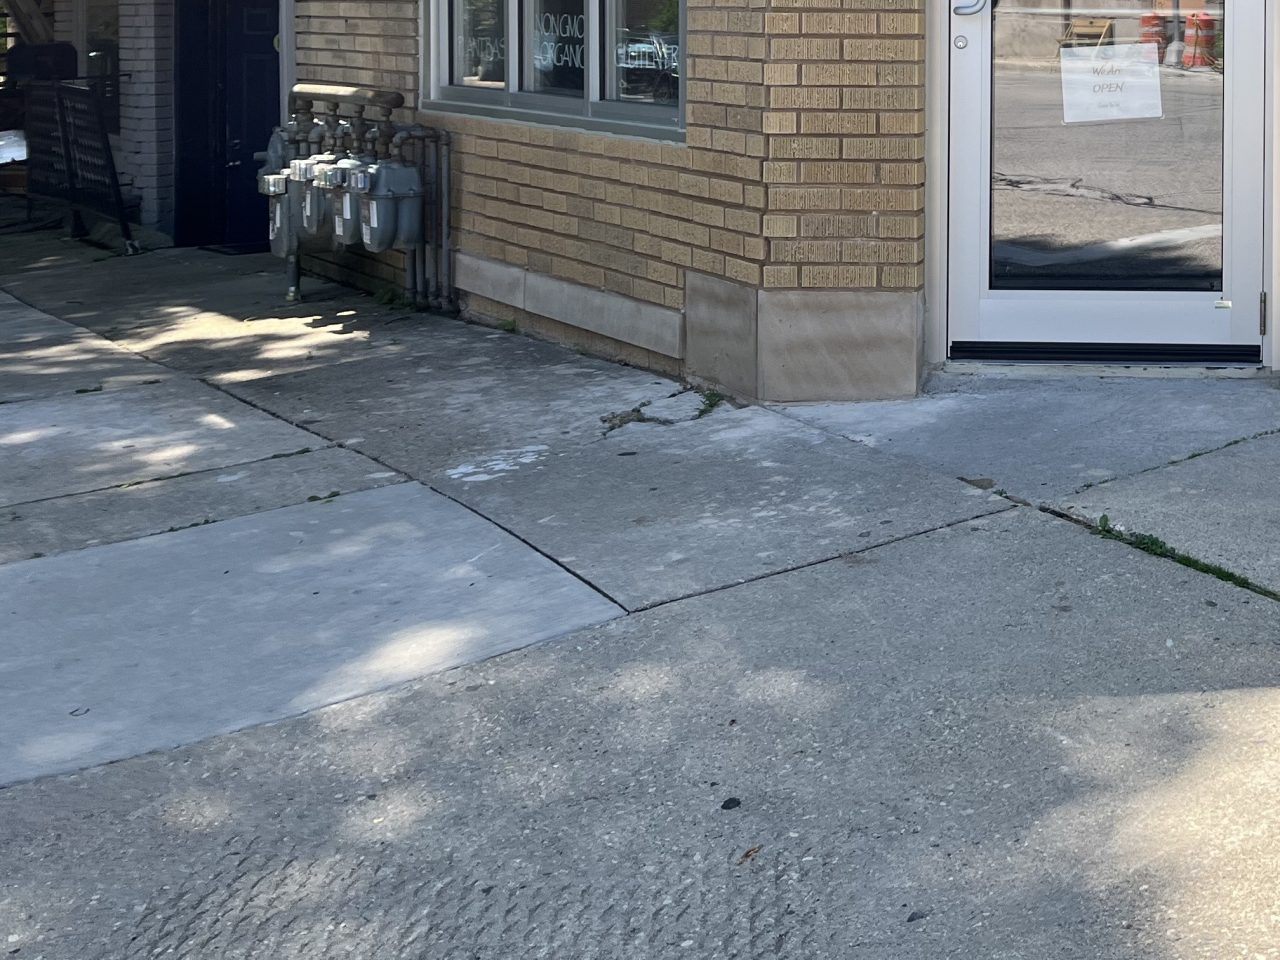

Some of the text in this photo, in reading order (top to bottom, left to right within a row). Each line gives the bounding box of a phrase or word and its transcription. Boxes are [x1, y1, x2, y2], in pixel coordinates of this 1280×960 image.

[535, 12, 585, 38] NON GMO
[1092, 81, 1126, 93] OPEN
